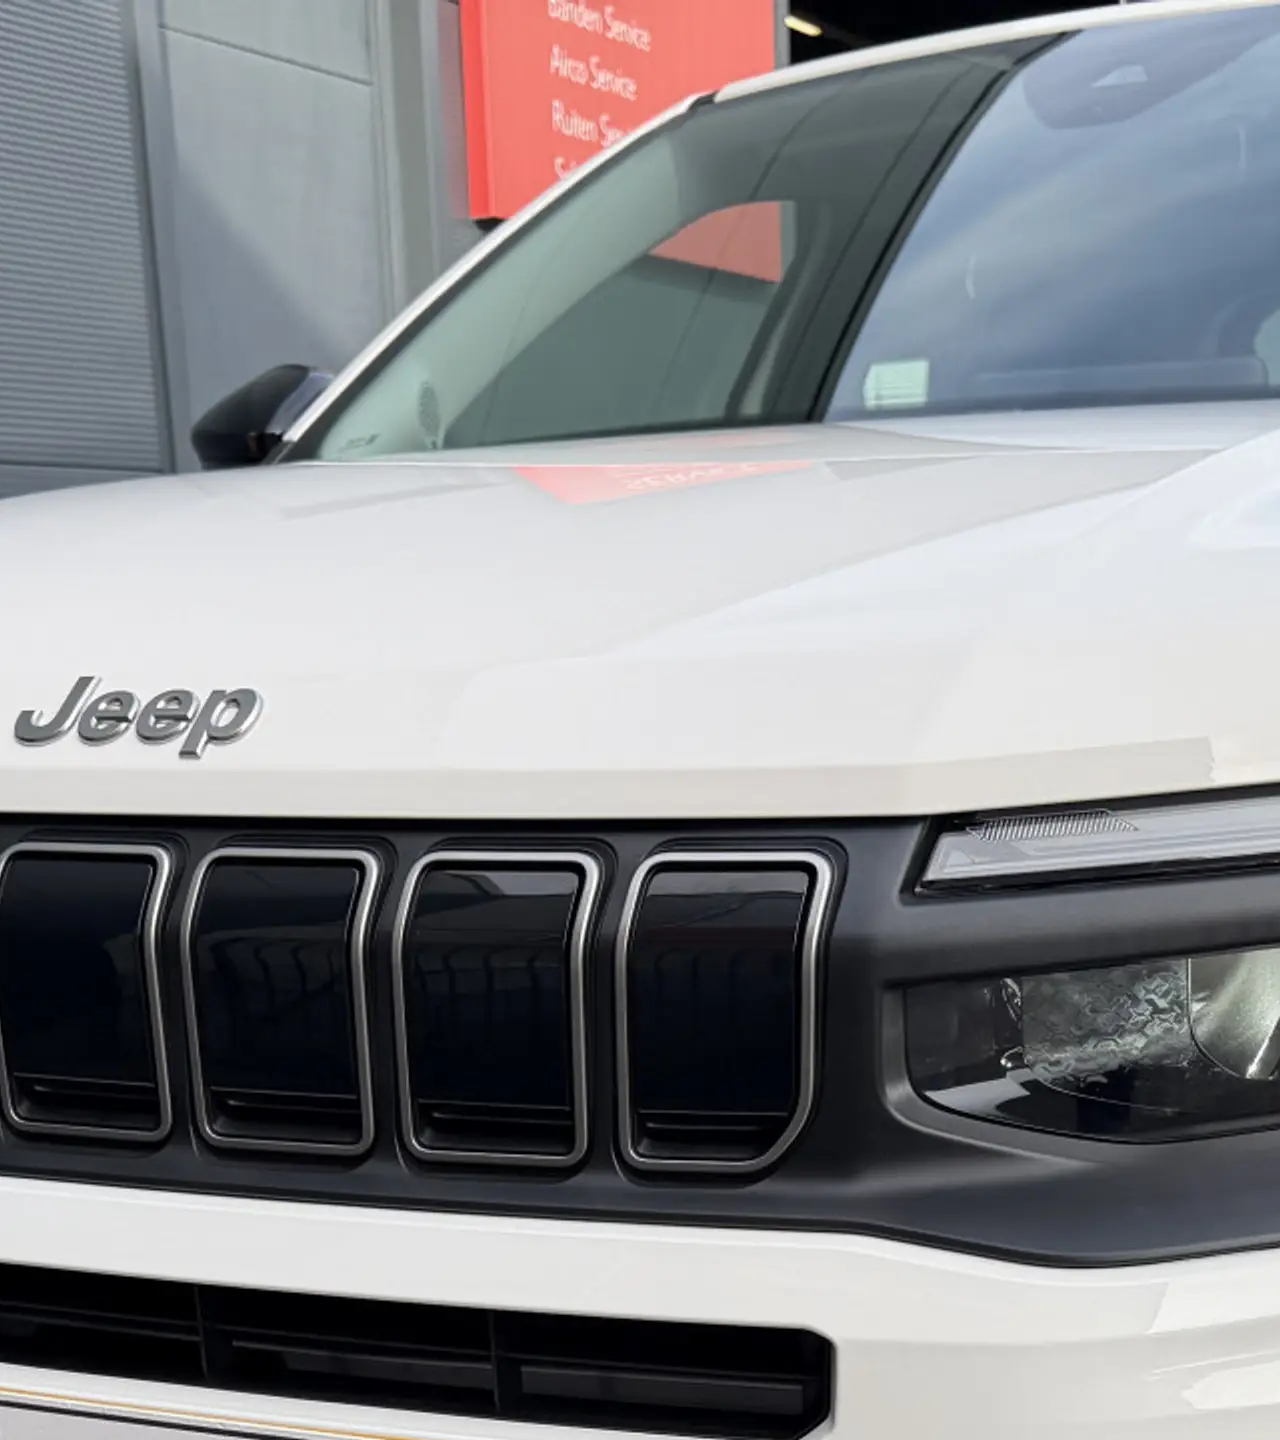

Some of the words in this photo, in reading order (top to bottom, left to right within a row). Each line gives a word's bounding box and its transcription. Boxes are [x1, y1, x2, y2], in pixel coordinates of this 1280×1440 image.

[604, 5, 651, 52] Service
[550, 44, 588, 86] Airco
[589, 55, 638, 101] Service
[14, 675, 263, 760] Jeep
